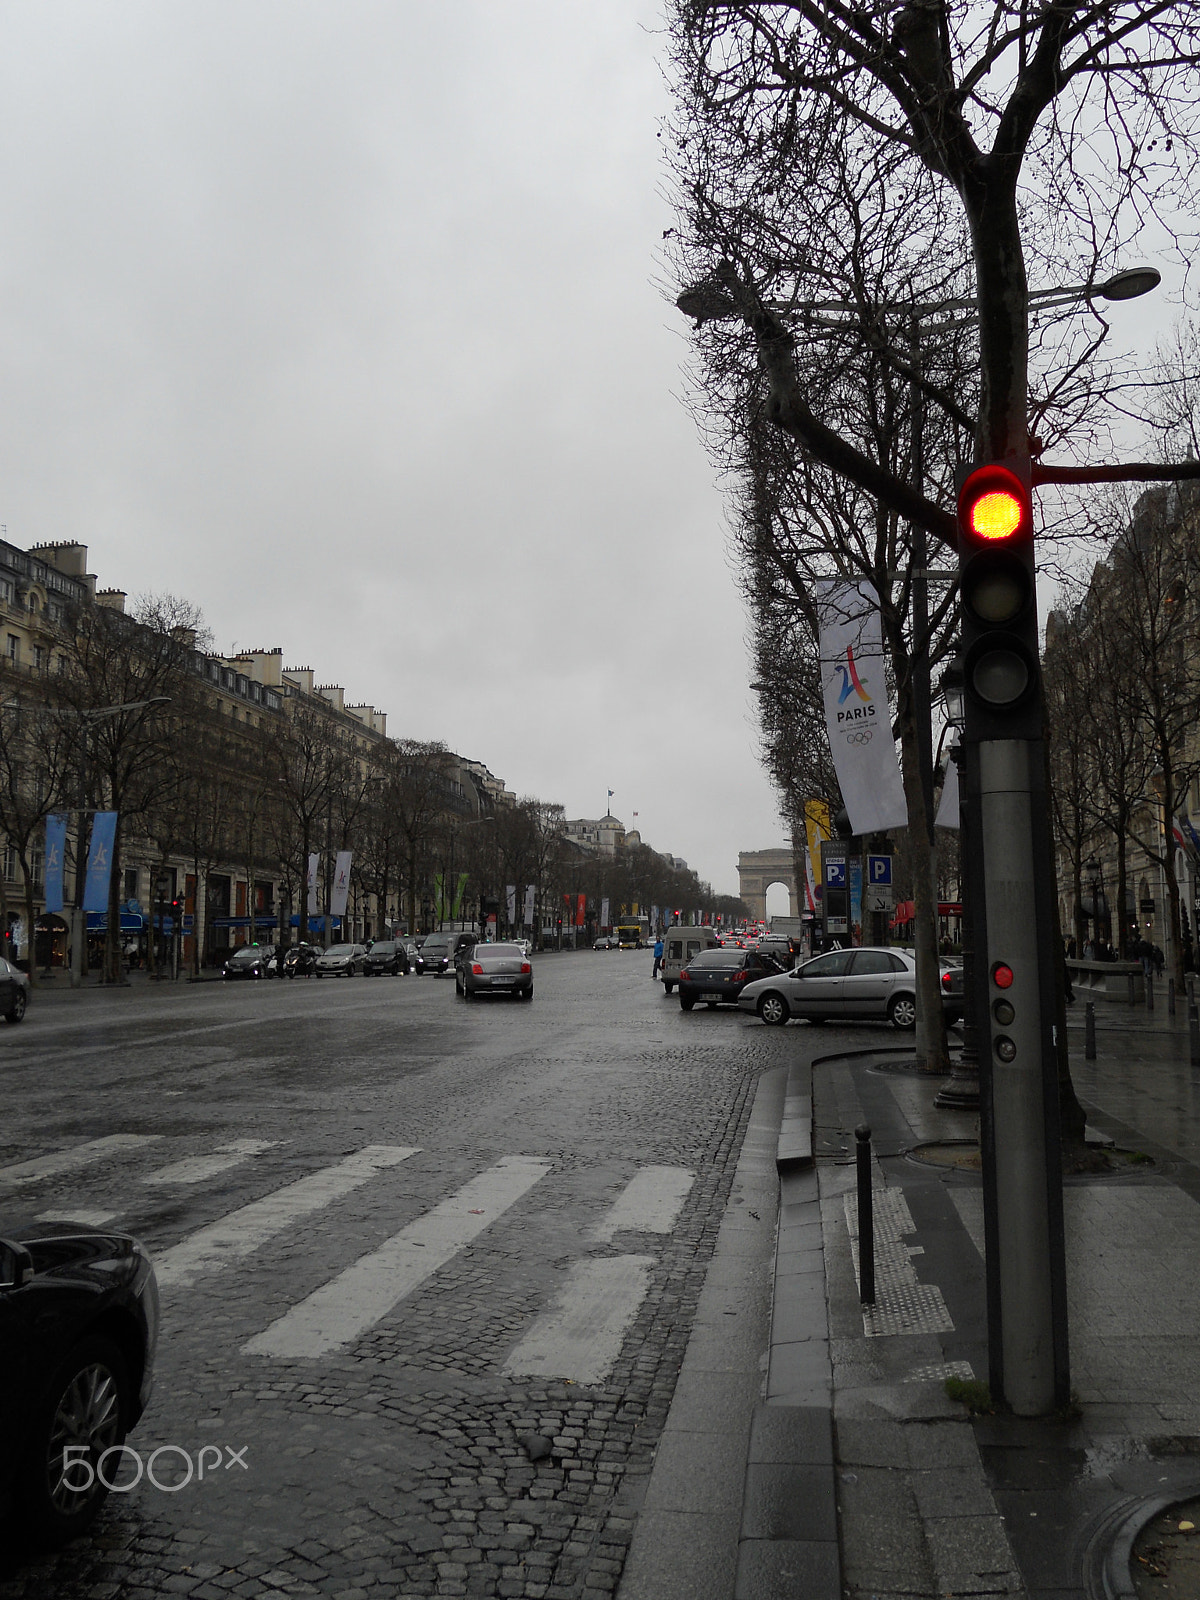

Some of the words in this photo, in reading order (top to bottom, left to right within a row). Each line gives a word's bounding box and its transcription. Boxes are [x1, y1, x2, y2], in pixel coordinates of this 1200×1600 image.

[837, 705, 875, 723] PARIS
[827, 866, 839, 882] P
[874, 861, 886, 880] P
